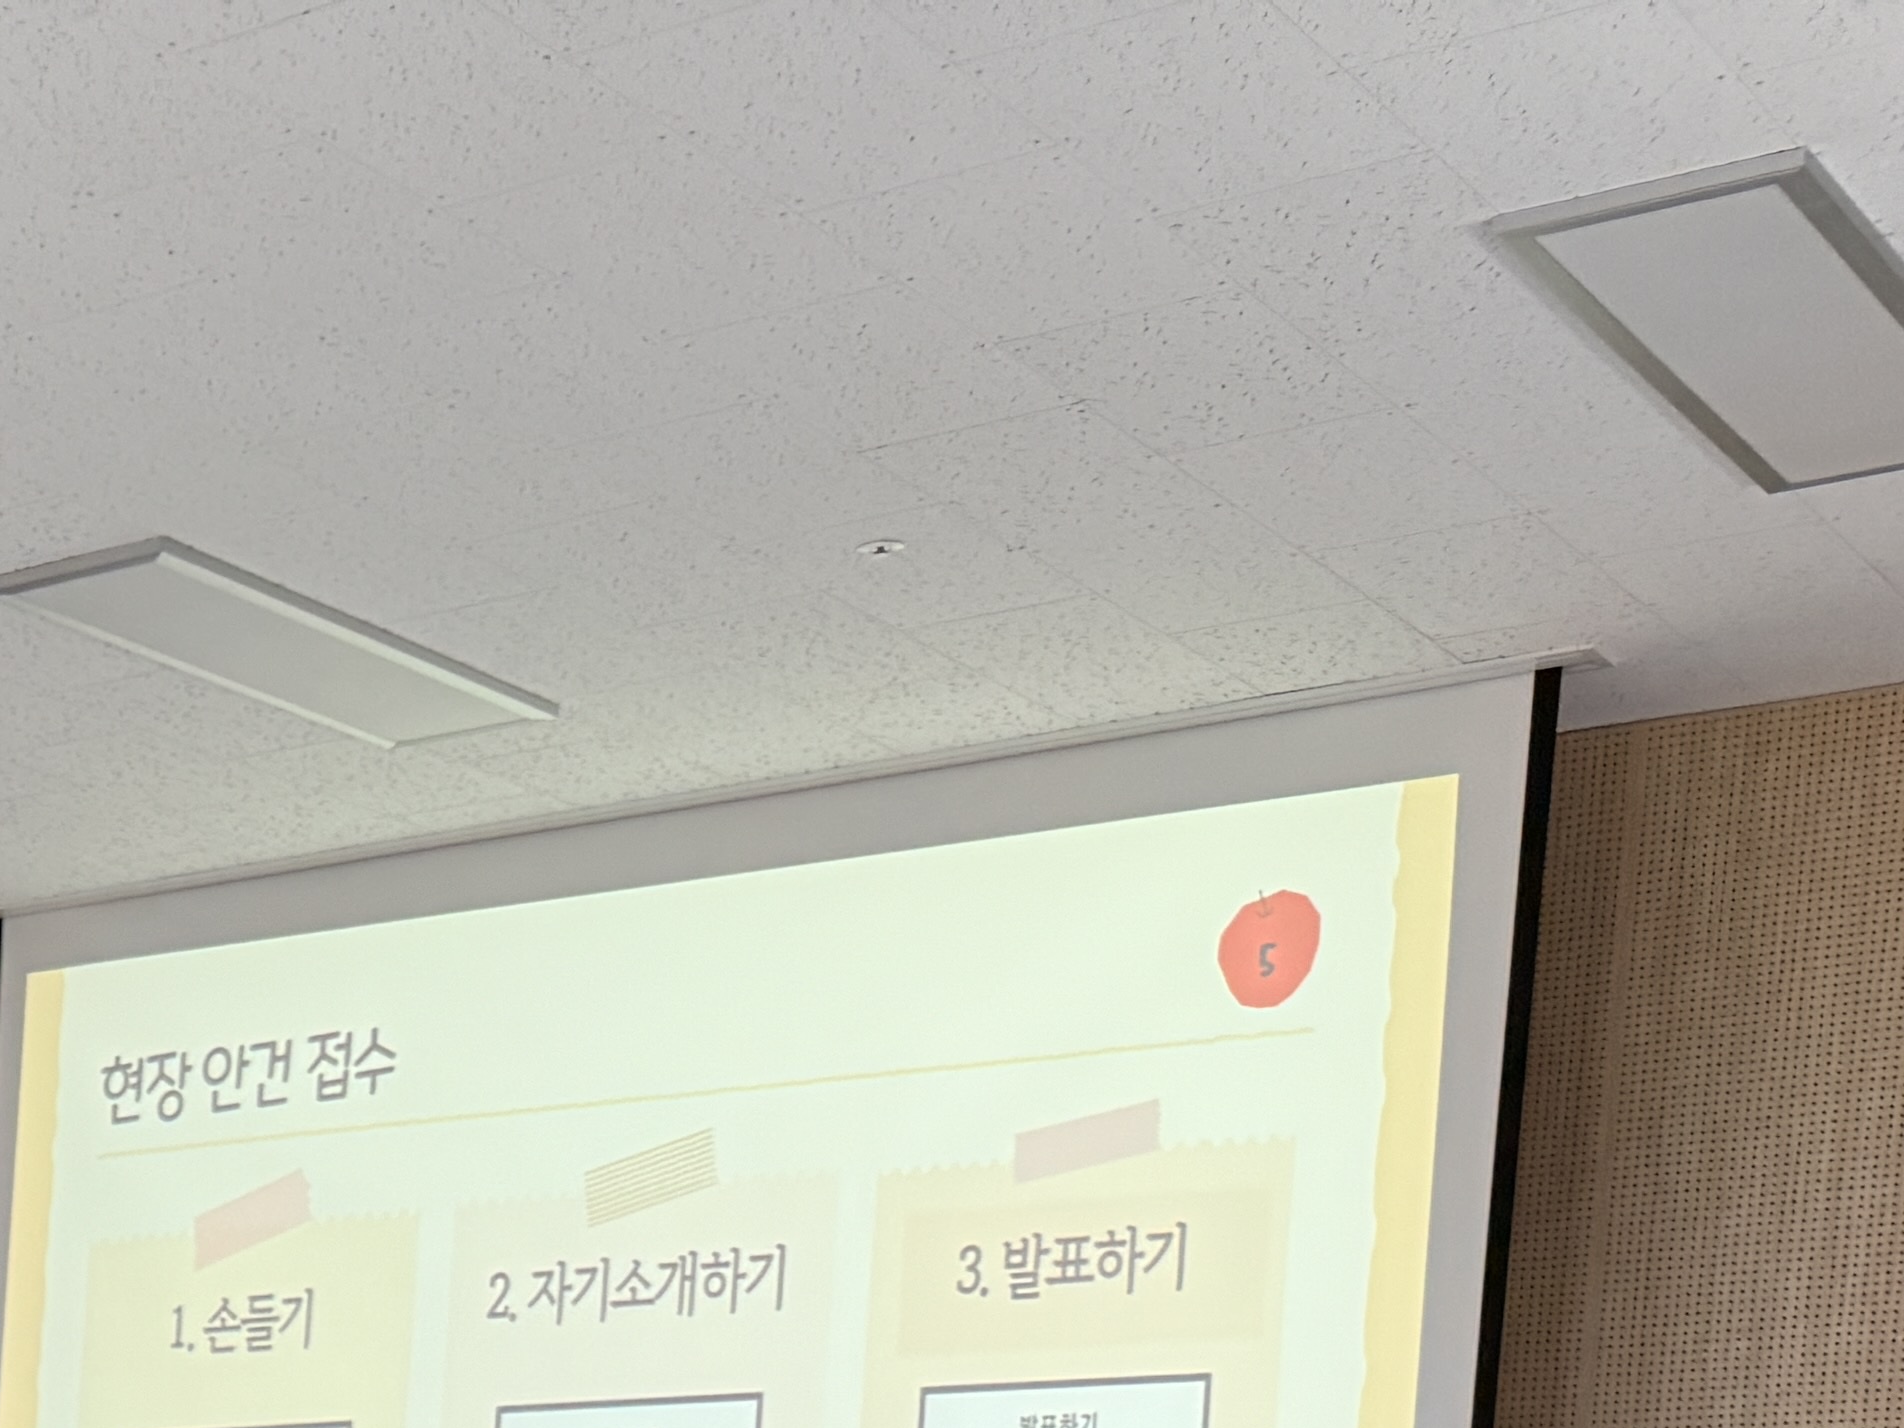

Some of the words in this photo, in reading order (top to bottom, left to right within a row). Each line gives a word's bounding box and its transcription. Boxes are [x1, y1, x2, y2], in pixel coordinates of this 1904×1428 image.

[1258, 942, 1279, 979] 5
[101, 1051, 194, 1126] 현장
[201, 1038, 293, 1114] 안건
[306, 1026, 398, 1102] 접수
[486, 1271, 517, 1323] 2.
[527, 1243, 787, 1326] 자기소개하기
[955, 1243, 990, 1298] 3.
[1002, 1221, 1188, 1301] 발표하기
[170, 1304, 196, 1352] 1.
[203, 1287, 314, 1354] 손들기
